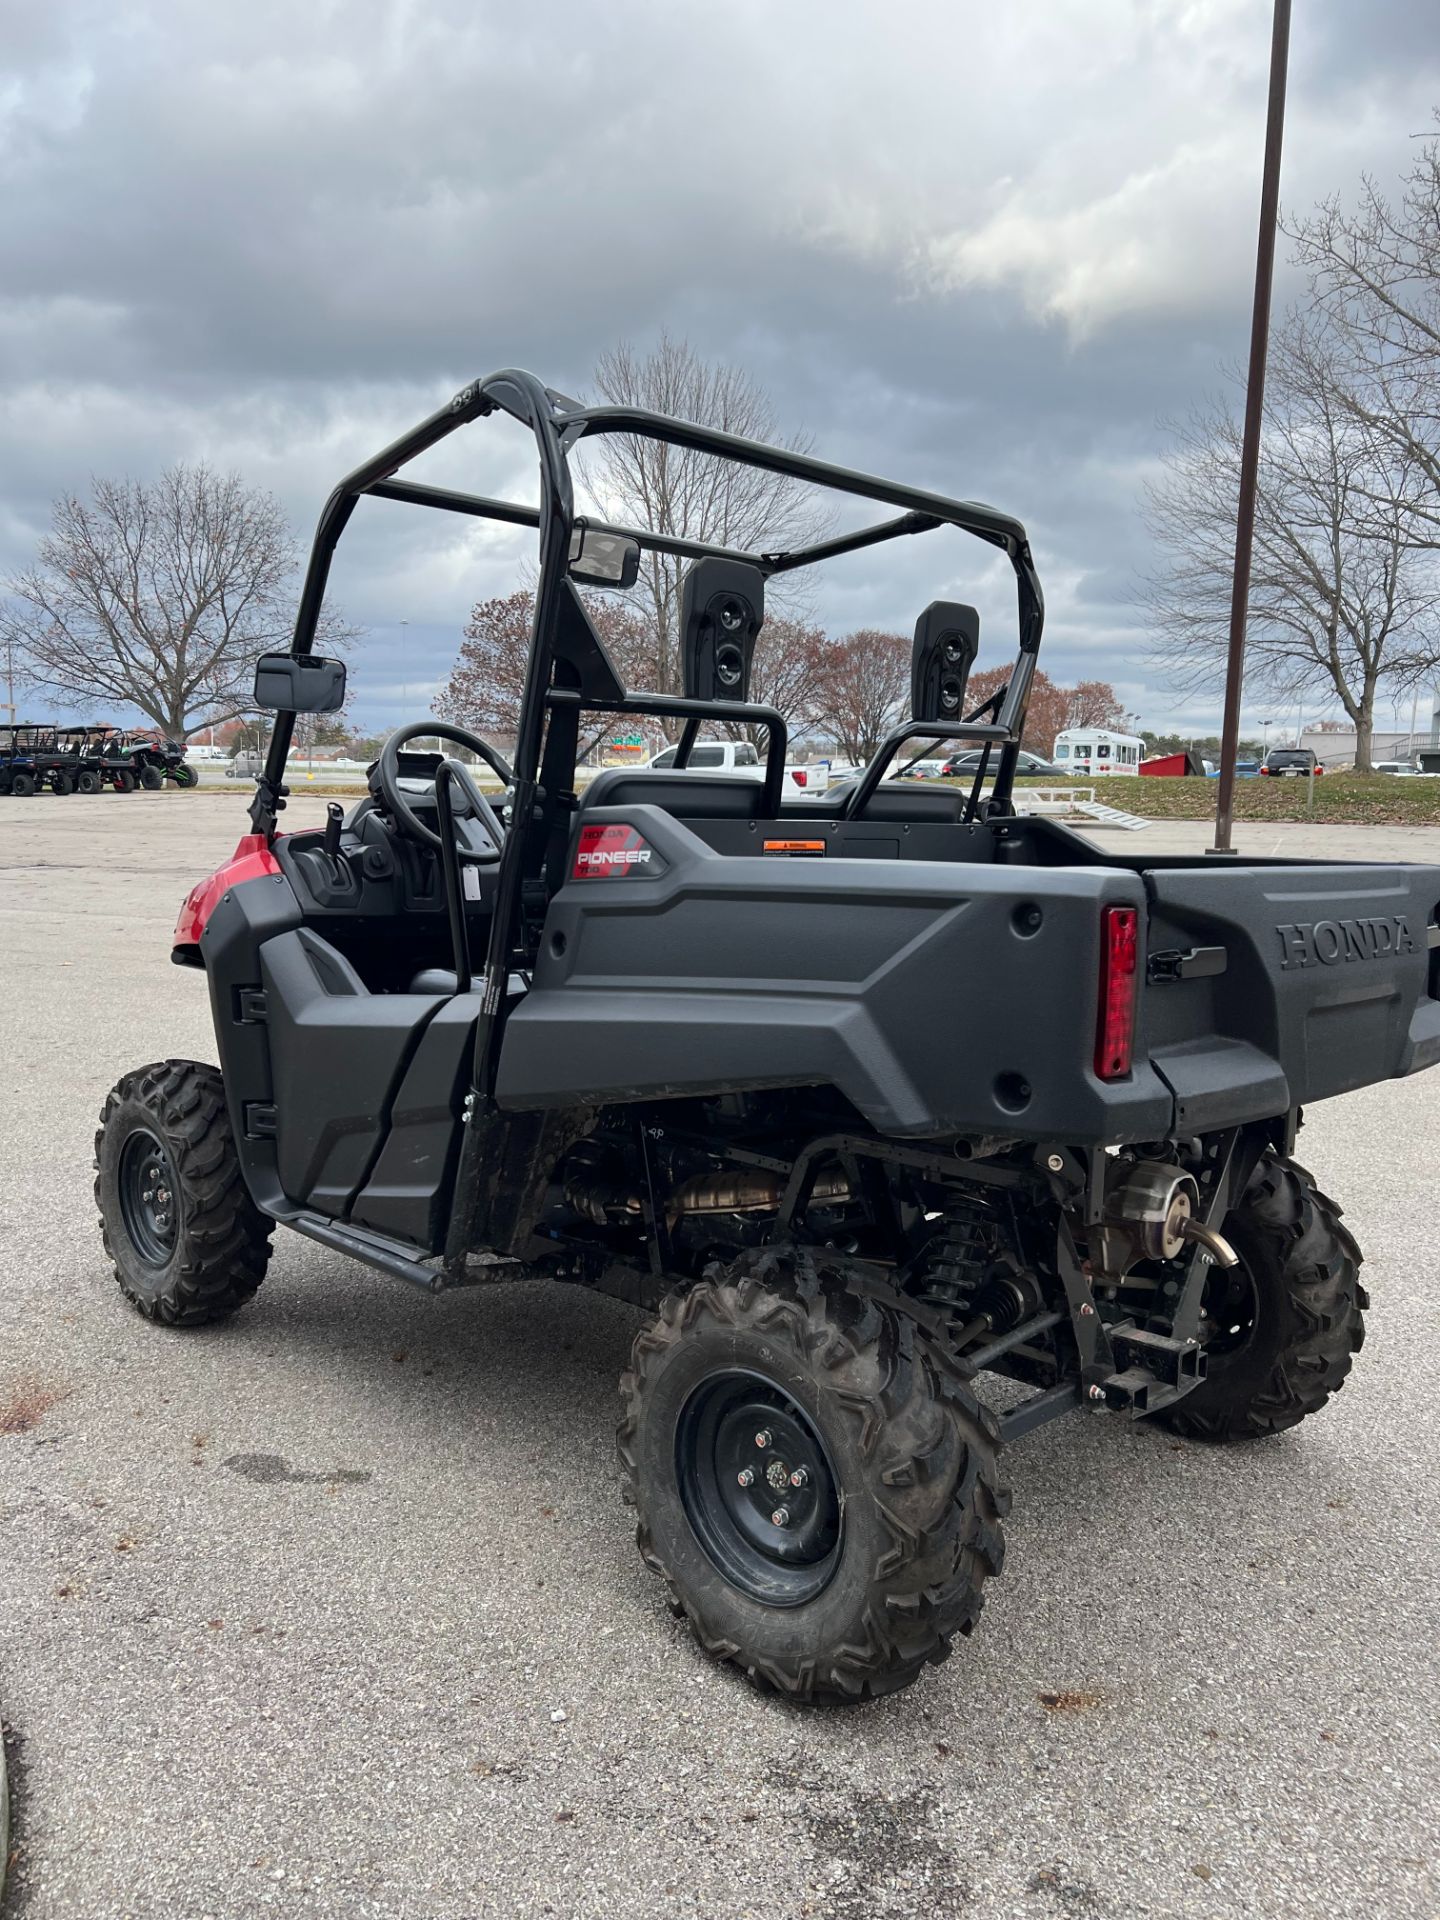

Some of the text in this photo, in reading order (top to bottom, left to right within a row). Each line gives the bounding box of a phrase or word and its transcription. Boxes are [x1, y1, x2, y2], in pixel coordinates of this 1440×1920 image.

[584, 829, 624, 839] HONDA
[577, 850, 651, 865] PIONEER
[1276, 915, 1423, 971] HONDA
